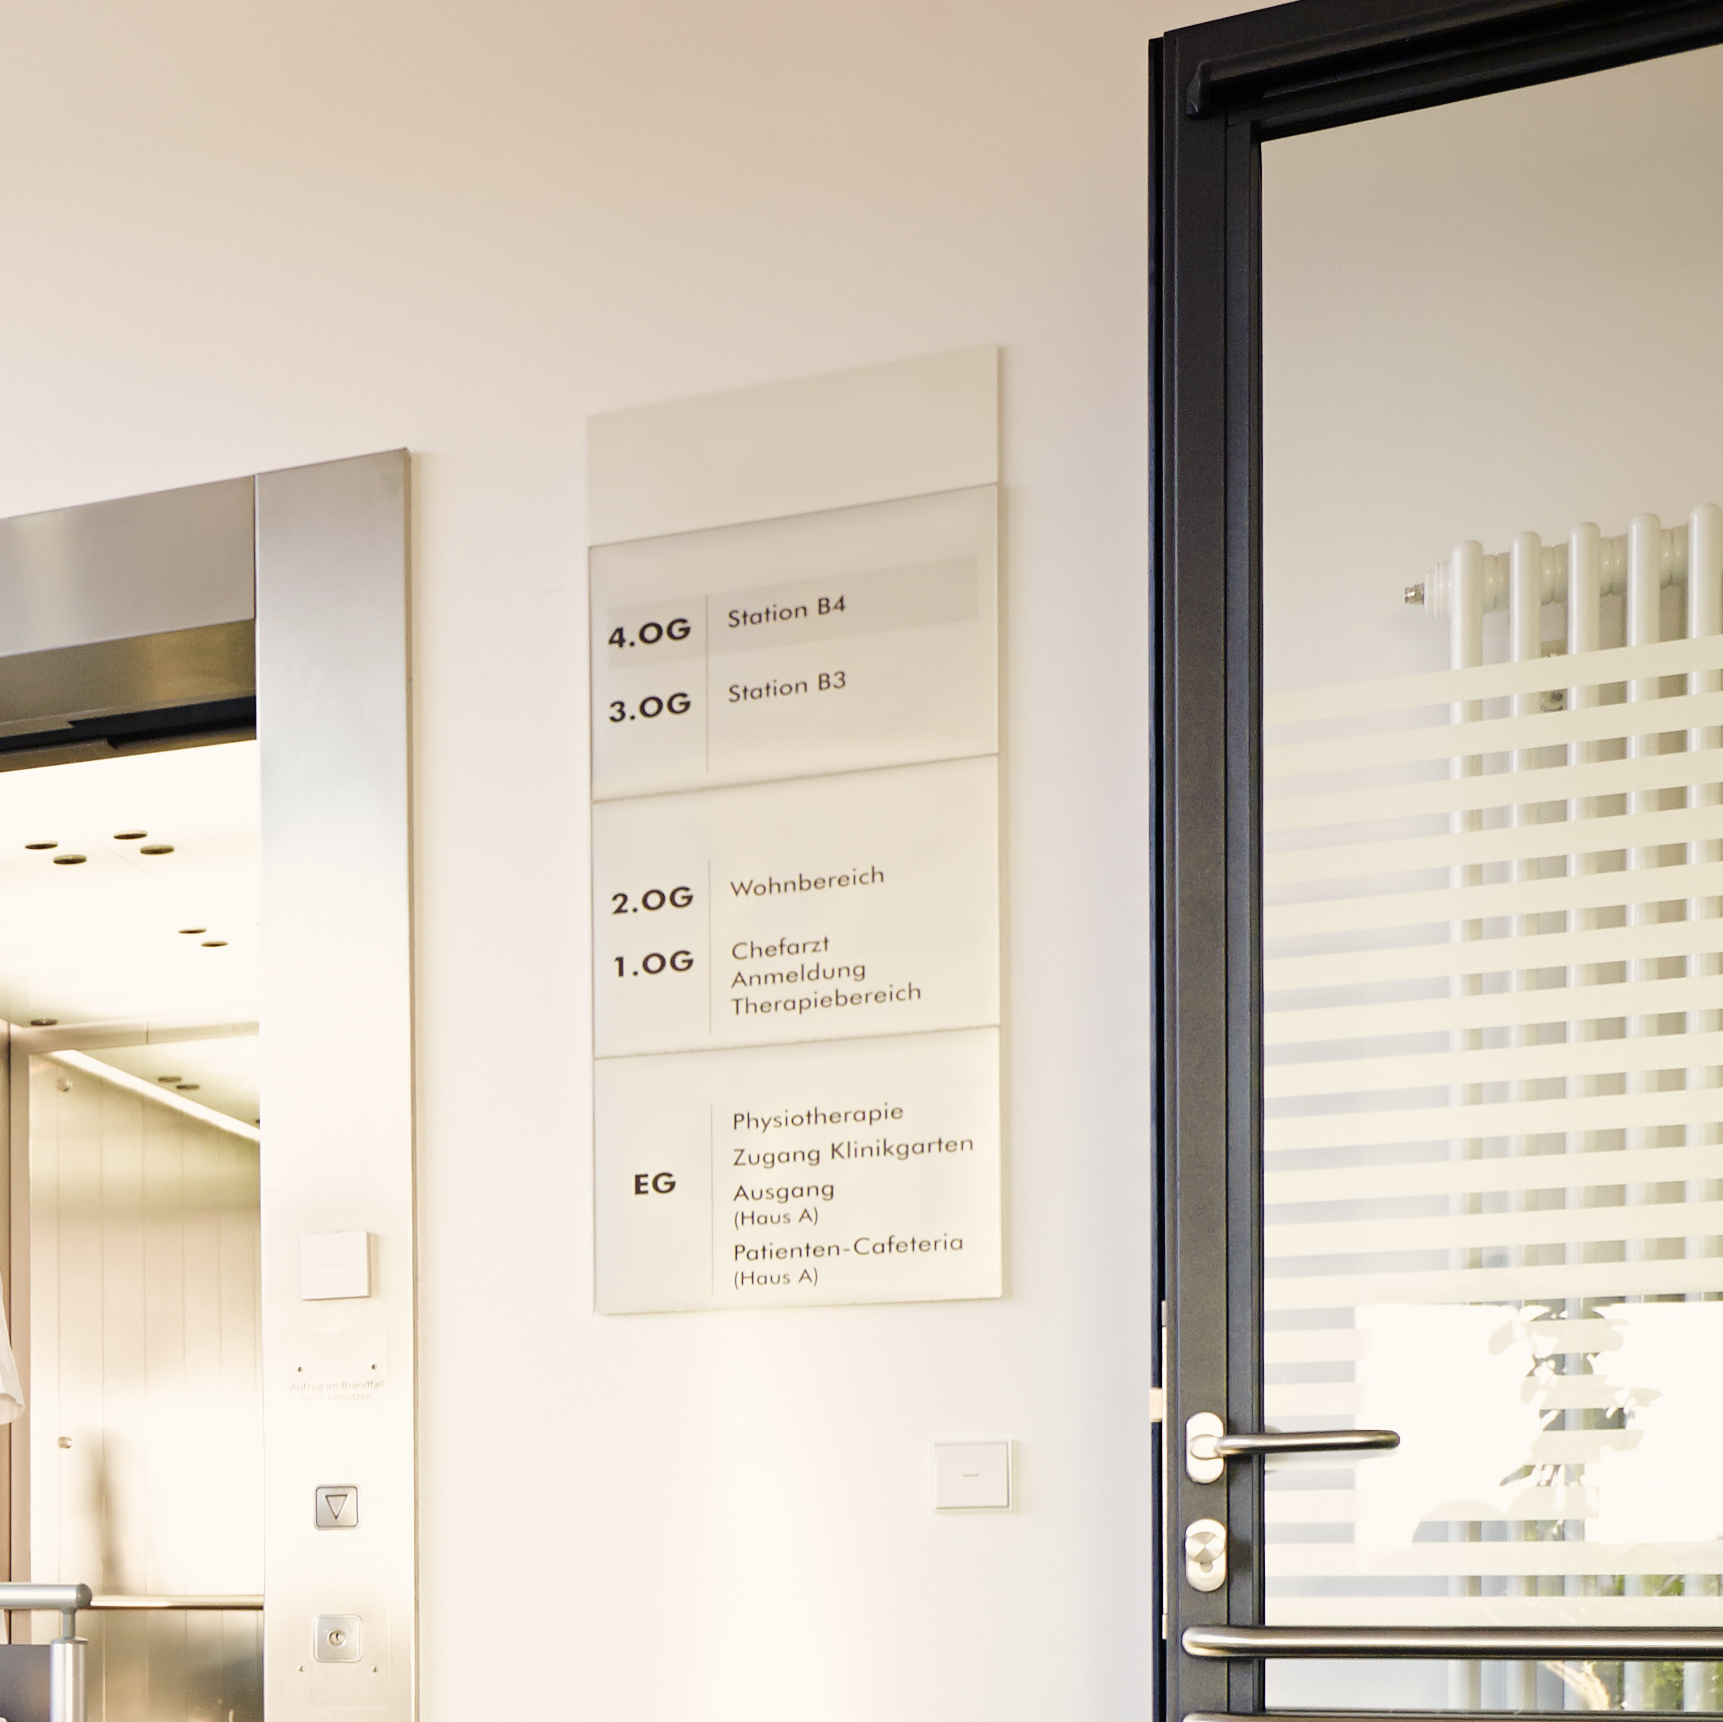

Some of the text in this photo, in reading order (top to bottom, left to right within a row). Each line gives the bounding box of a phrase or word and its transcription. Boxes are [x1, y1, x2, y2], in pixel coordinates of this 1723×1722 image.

[727, 595, 846, 629] Station B4
[607, 617, 692, 649] 4.OG
[728, 670, 846, 704] Station B3
[608, 691, 692, 724] 3.OG
[729, 865, 885, 897] Wohnbereich
[611, 885, 694, 916] 2.OG
[731, 936, 830, 960] Chefarzt
[613, 949, 694, 978] 1.OG
[731, 962, 866, 988] Anmeldung
[731, 981, 921, 1016] Therapiebereich
[733, 1102, 904, 1134] Physiotherapie
[732, 1137, 973, 1170] Zugang Klinikgarten
[633, 1171, 677, 1196] EG
[732, 1184, 835, 1205] Ausgang
[734, 1206, 819, 1231] (Haus A)
[733, 1234, 963, 1262] Patienten-Cafeteria
[733, 1267, 818, 1290] (Haus A)
[341, 1379, 385, 1390] Brandfall
